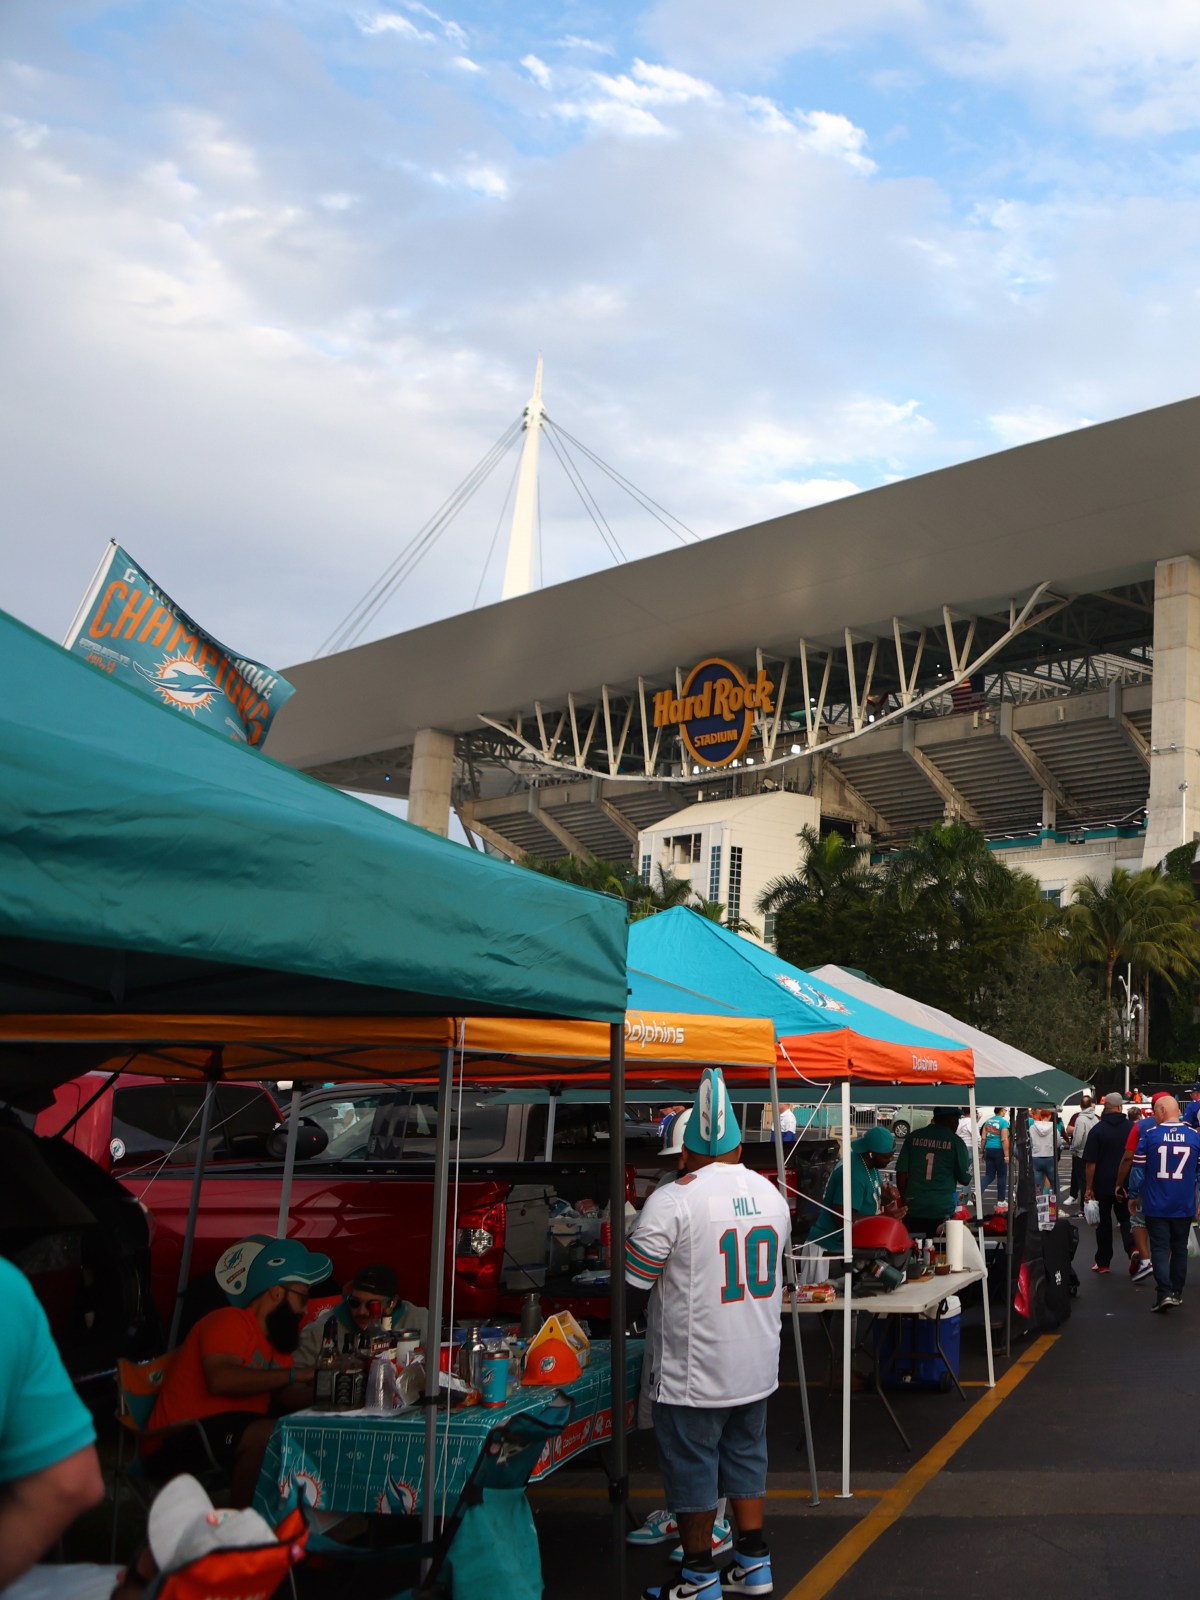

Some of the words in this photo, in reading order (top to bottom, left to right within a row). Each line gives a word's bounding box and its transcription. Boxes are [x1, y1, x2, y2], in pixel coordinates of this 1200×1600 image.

[653, 681, 714, 728] Hard
[713, 669, 775, 722] Rock
[694, 729, 739, 748] STADIUM
[1163, 1132, 1185, 1143] ALLEN
[925, 1152, 935, 1180] 1
[1157, 1145, 1191, 1180] 17
[732, 1197, 762, 1216] HILL
[719, 1225, 779, 1304] 10
